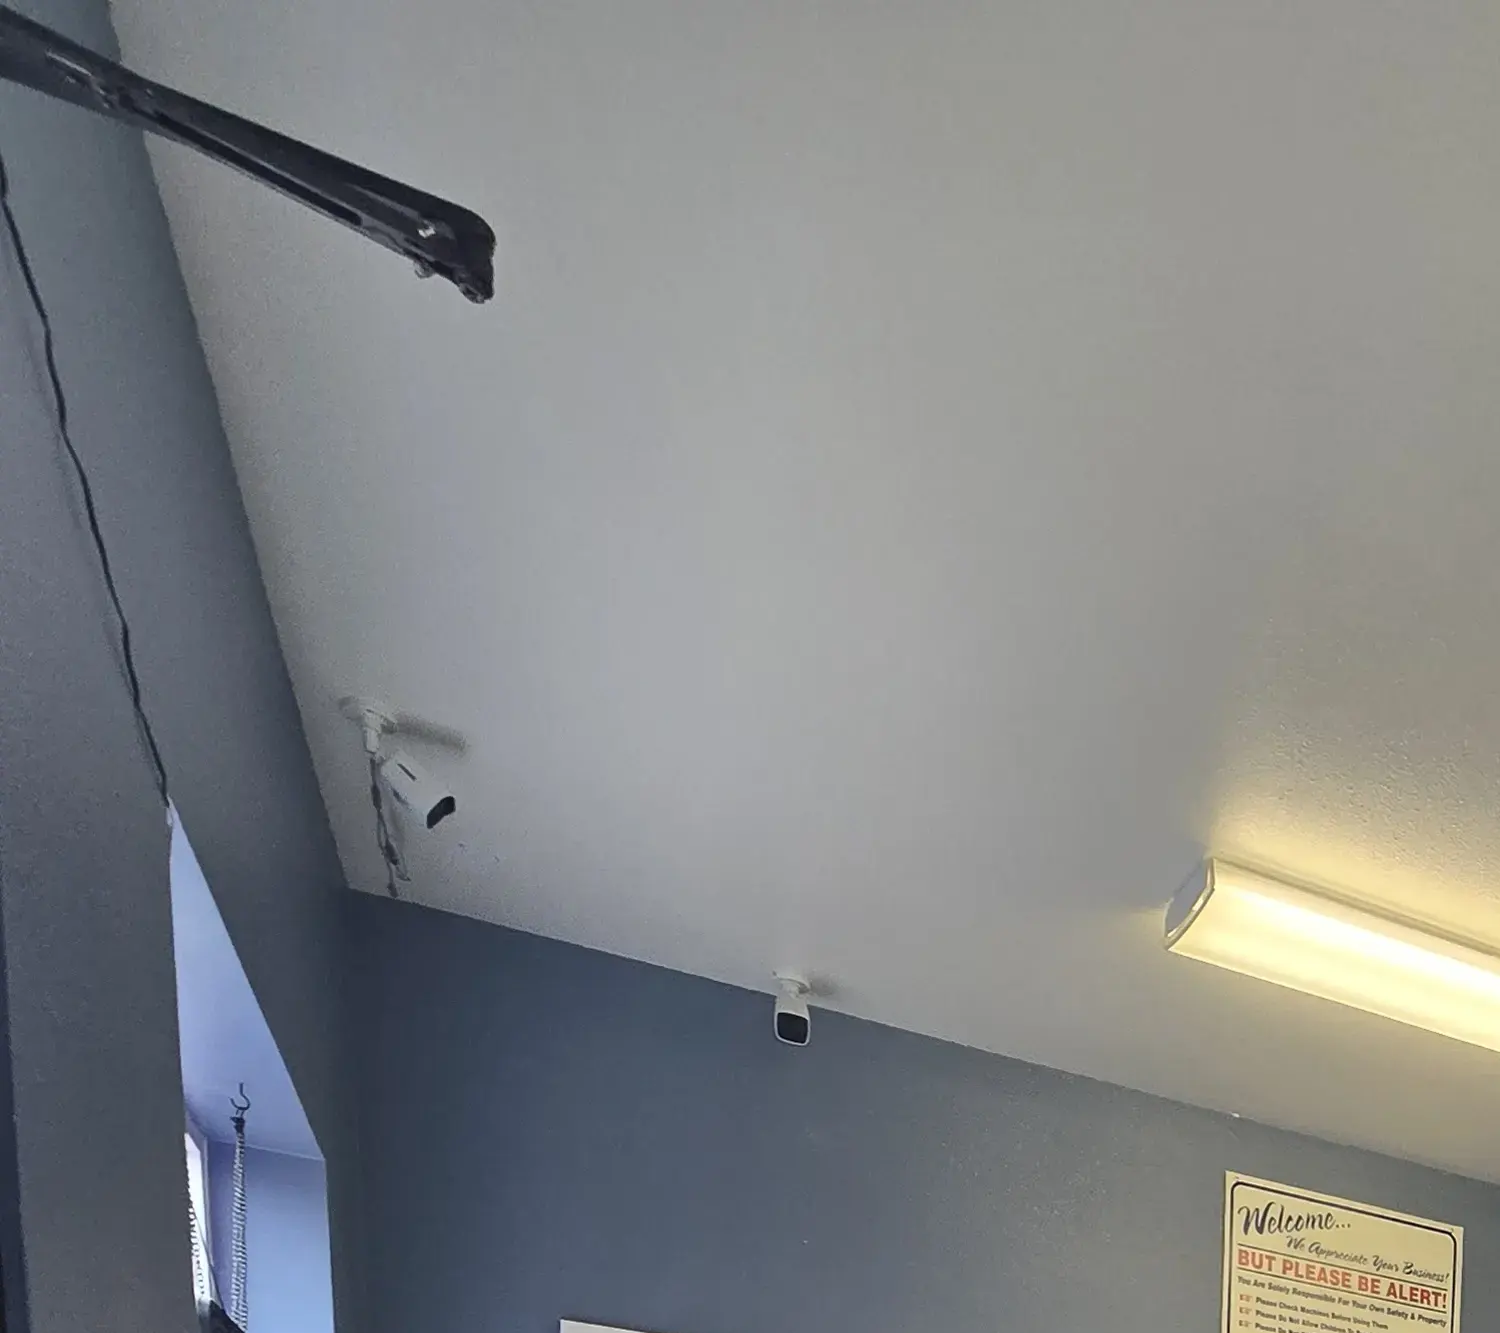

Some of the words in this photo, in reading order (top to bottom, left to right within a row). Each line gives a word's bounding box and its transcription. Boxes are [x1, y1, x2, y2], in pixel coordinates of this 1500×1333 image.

[1286, 1235, 1305, 1251] We
[1372, 1255, 1399, 1272] Your
[1238, 1249, 1276, 1272] BUT
[1282, 1259, 1352, 1289] PLEASE
[1357, 1275, 1381, 1295] BE
[1386, 1282, 1447, 1309] ALERT!
